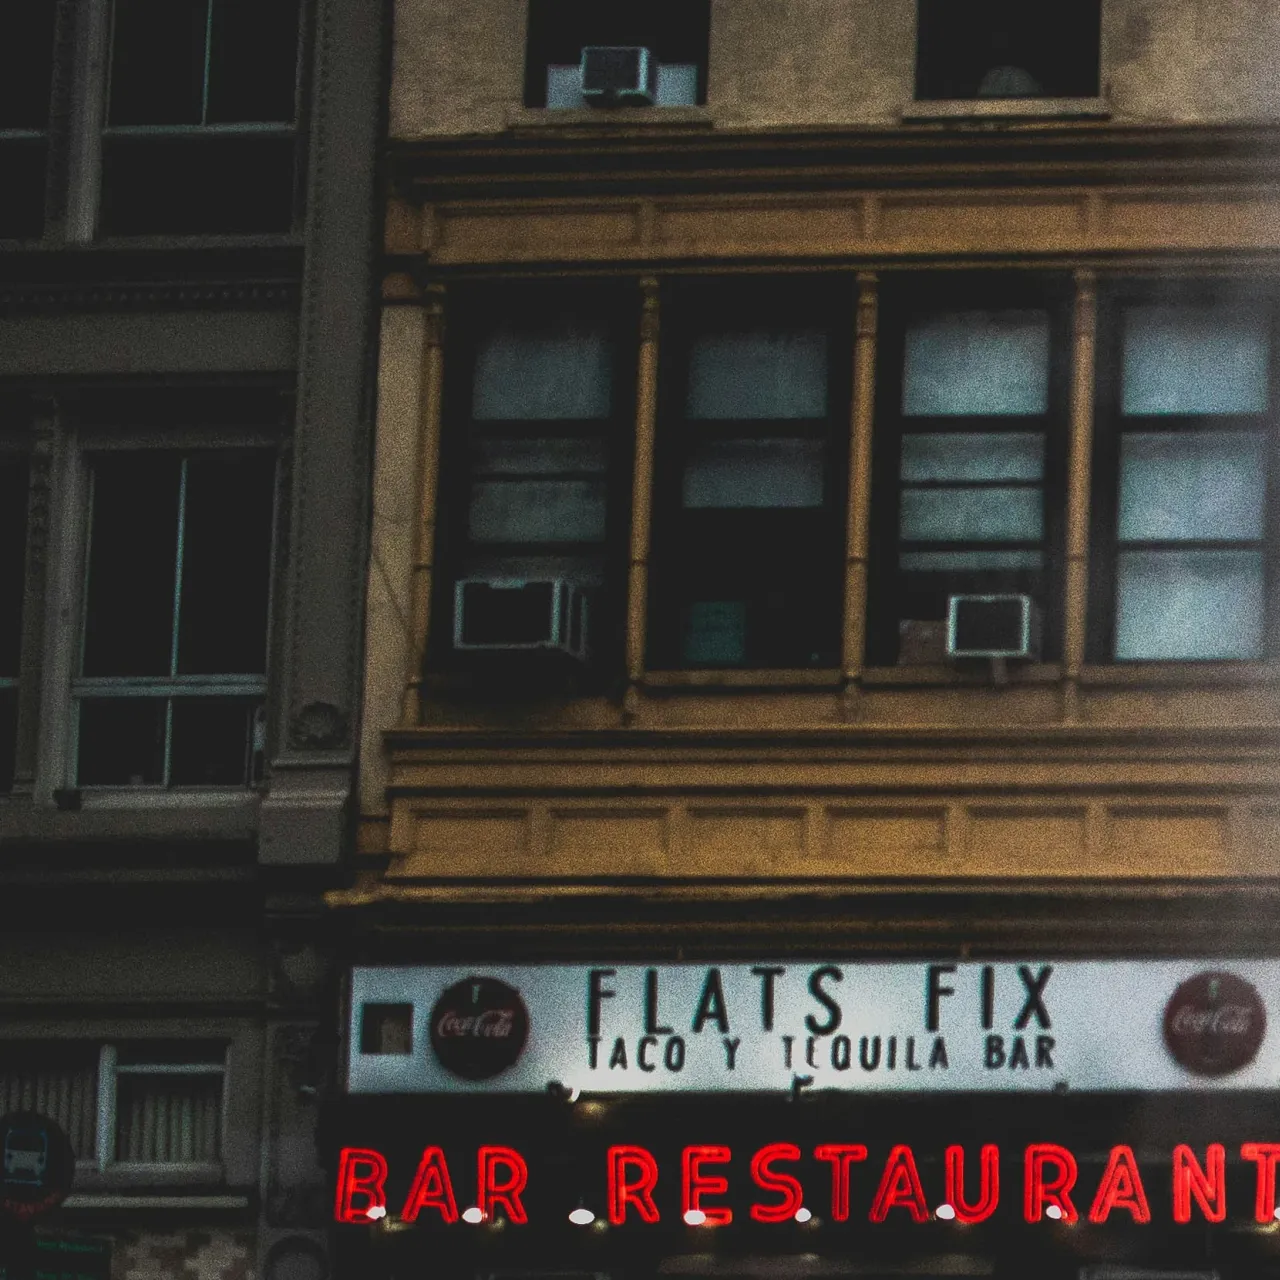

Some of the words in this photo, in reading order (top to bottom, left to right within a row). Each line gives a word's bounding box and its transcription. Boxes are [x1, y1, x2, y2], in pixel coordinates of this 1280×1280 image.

[587, 966, 844, 1037] FLATS
[925, 966, 1054, 1033] FIX
[586, 1035, 687, 1072] TACO
[720, 1036, 740, 1070] Y
[782, 1034, 948, 1072] TEQUILA
[984, 1035, 1055, 1070] BAR
[335, 1144, 527, 1226] BAR
